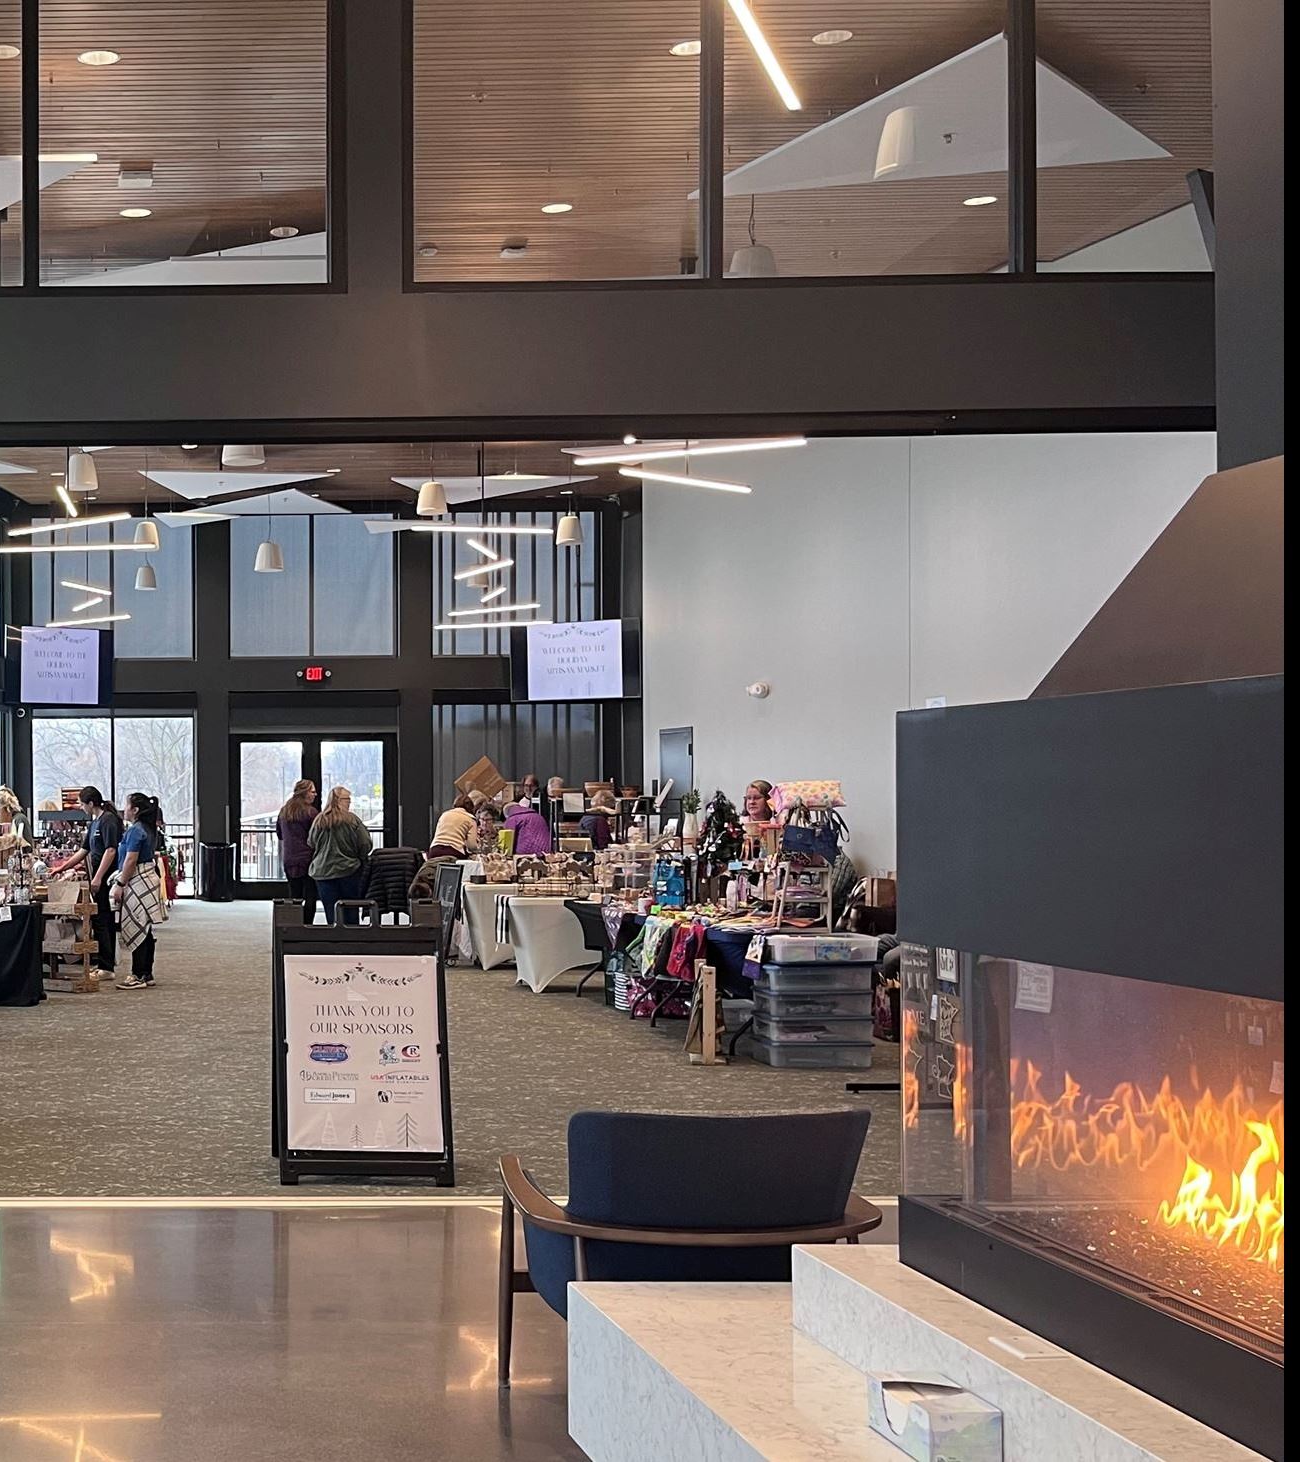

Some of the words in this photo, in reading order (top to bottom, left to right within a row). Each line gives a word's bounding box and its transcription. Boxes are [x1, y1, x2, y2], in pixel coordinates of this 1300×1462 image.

[306, 667, 322, 680] EXIT
[316, 1005, 355, 1017] THANK
[361, 1005, 390, 1017] YOU
[396, 1005, 415, 1017] TO
[310, 1022, 338, 1034] OUR
[343, 1023, 414, 1035] SPONSORS
